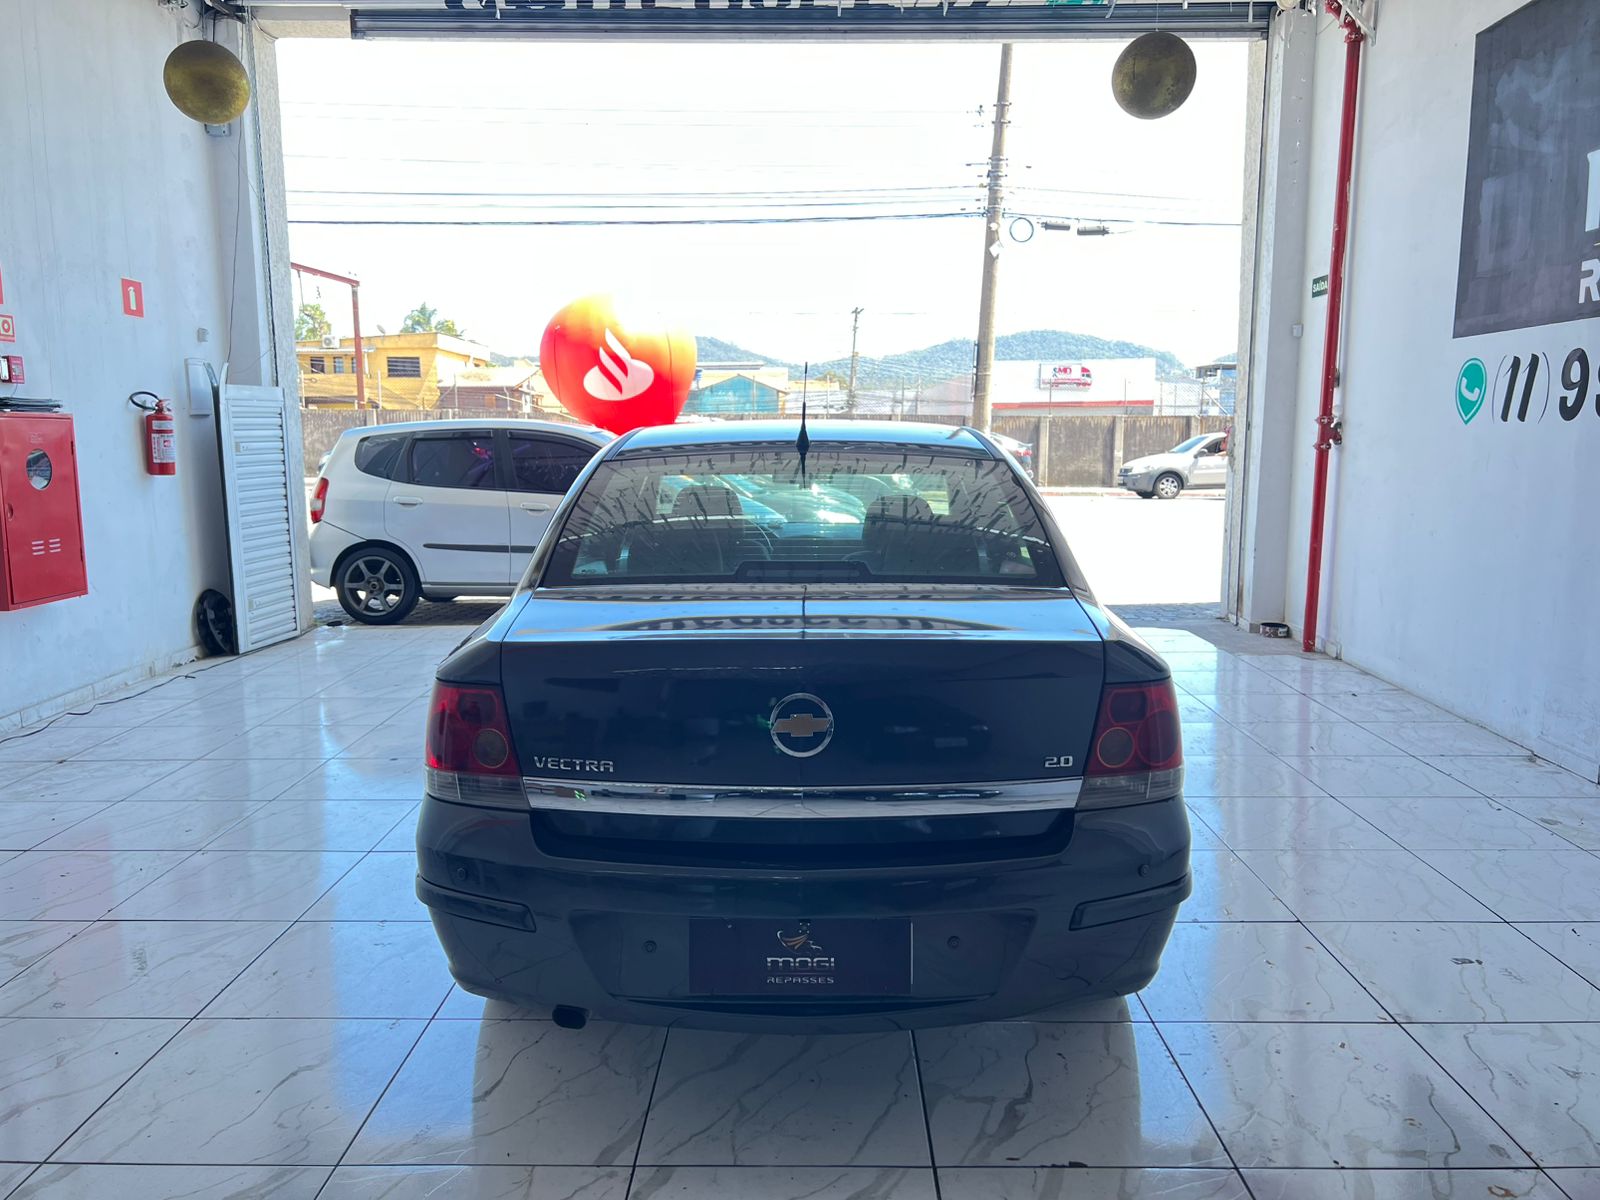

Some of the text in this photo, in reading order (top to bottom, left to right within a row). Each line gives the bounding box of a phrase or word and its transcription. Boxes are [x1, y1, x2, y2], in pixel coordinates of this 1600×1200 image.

[1491, 347, 1600, 424] (11) 9
[533, 756, 614, 773] VECTRA
[1044, 755, 1073, 768] 2.0
[766, 957, 835, 971] MOGI
[766, 976, 834, 984] REPASSES
